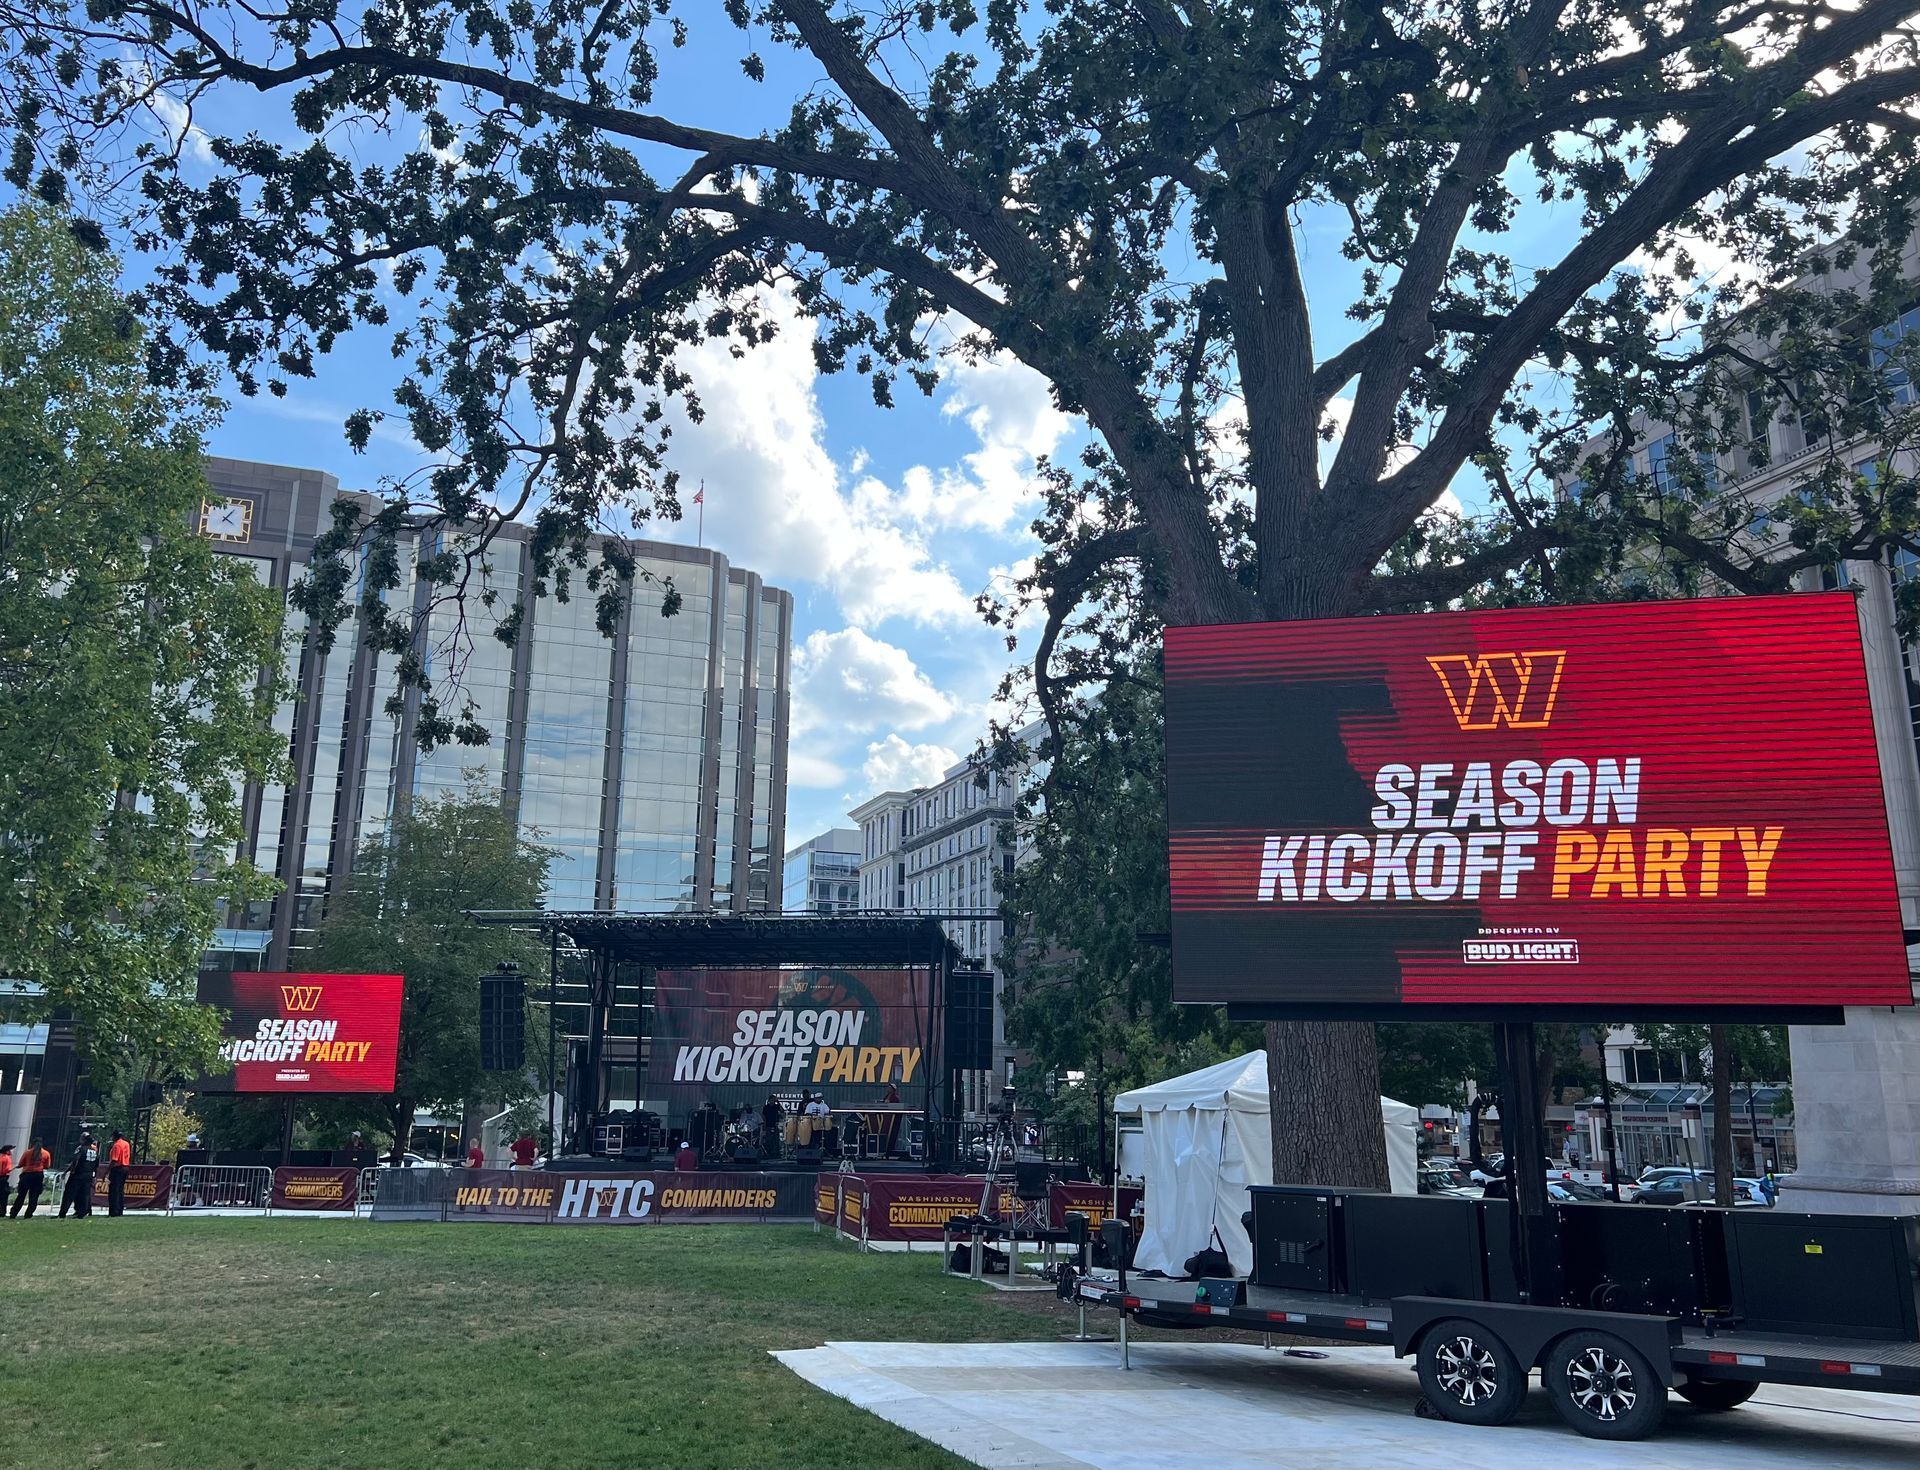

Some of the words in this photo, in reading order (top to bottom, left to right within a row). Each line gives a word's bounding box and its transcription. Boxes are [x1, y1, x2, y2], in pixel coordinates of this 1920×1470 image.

[1371, 758, 1641, 829] SEASON
[1257, 831, 1540, 901] KICKOFF
[1551, 826, 1784, 898] PARTY
[1467, 944, 1511, 959] BUD
[1512, 944, 1573, 959] LIGHT
[255, 1018, 338, 1041] SEASON
[732, 1010, 865, 1046] SEASON
[305, 1041, 372, 1062] PARTY
[673, 1046, 812, 1083] KICKOFF
[811, 1047, 922, 1083] PARTY
[95, 1182, 157, 1195] COANDERS
[284, 1184, 343, 1197] COMMANDERS
[456, 1187, 492, 1206] HAIL
[496, 1188, 519, 1206] TO
[522, 1188, 554, 1207] THE
[557, 1180, 655, 1217] HTTC
[660, 1189, 777, 1208] COMMANDERS
